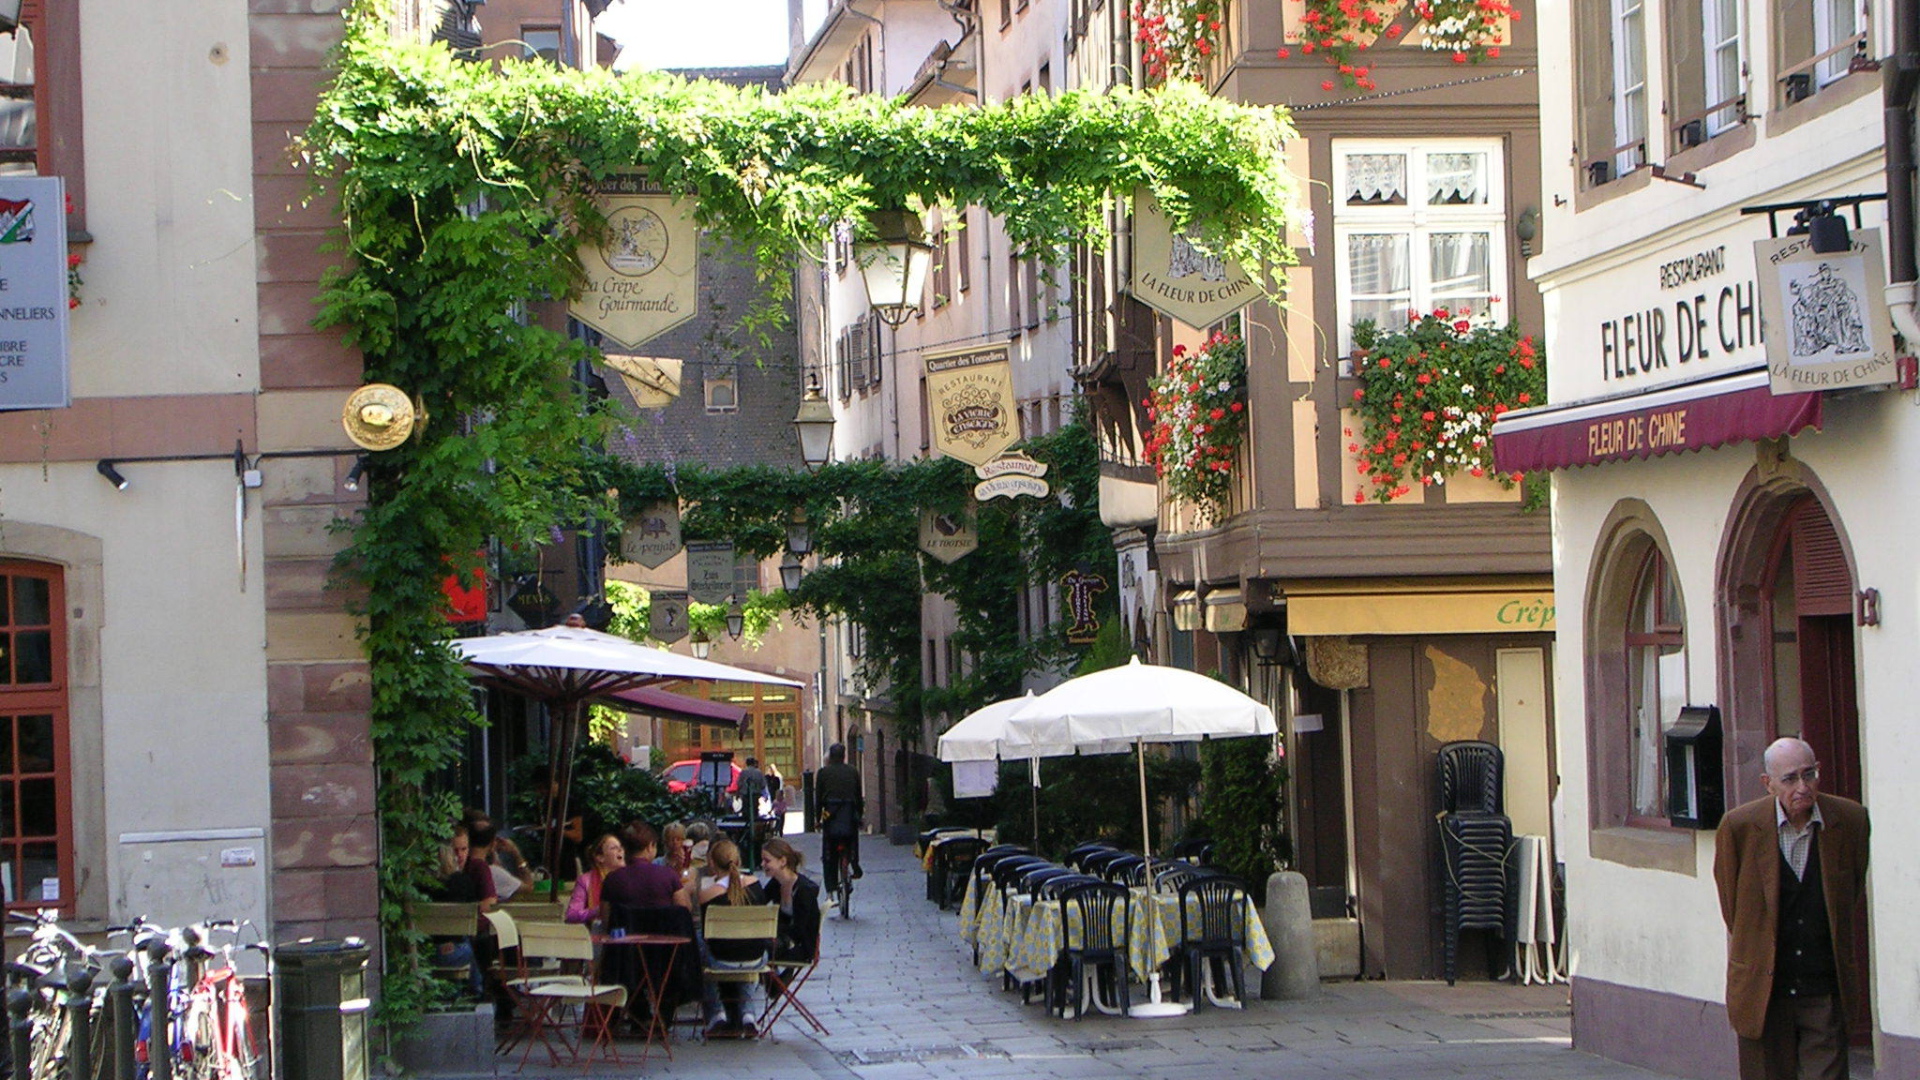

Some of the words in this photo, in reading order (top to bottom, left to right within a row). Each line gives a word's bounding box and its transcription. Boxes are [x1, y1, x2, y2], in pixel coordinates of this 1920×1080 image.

[1659, 245, 1726, 290] RESTAURANT
[602, 276, 644, 299] Crêpe
[1141, 272, 1155, 290] LA
[1157, 281, 1195, 304] FLEUR
[1198, 290, 1215, 304] DE
[598, 293, 680, 320] Gourmande
[1601, 306, 1668, 381] FLEUR
[1676, 294, 1710, 364] DE
[928, 359, 957, 372] Quartier
[957, 356, 970, 367] des
[970, 351, 1005, 364] Tonneliers
[1772, 362, 1789, 379] LA
[1791, 369, 1829, 385] FLEUR
[1833, 370, 1850, 383] DE
[1853, 351, 1893, 378] CHINE
[938, 374, 1003, 395] RESTAURANT
[1588, 419, 1625, 458] FLEUR
[1627, 416, 1645, 451] DE
[1648, 409, 1687, 449] CHINE
[983, 459, 1038, 476] Restaurant
